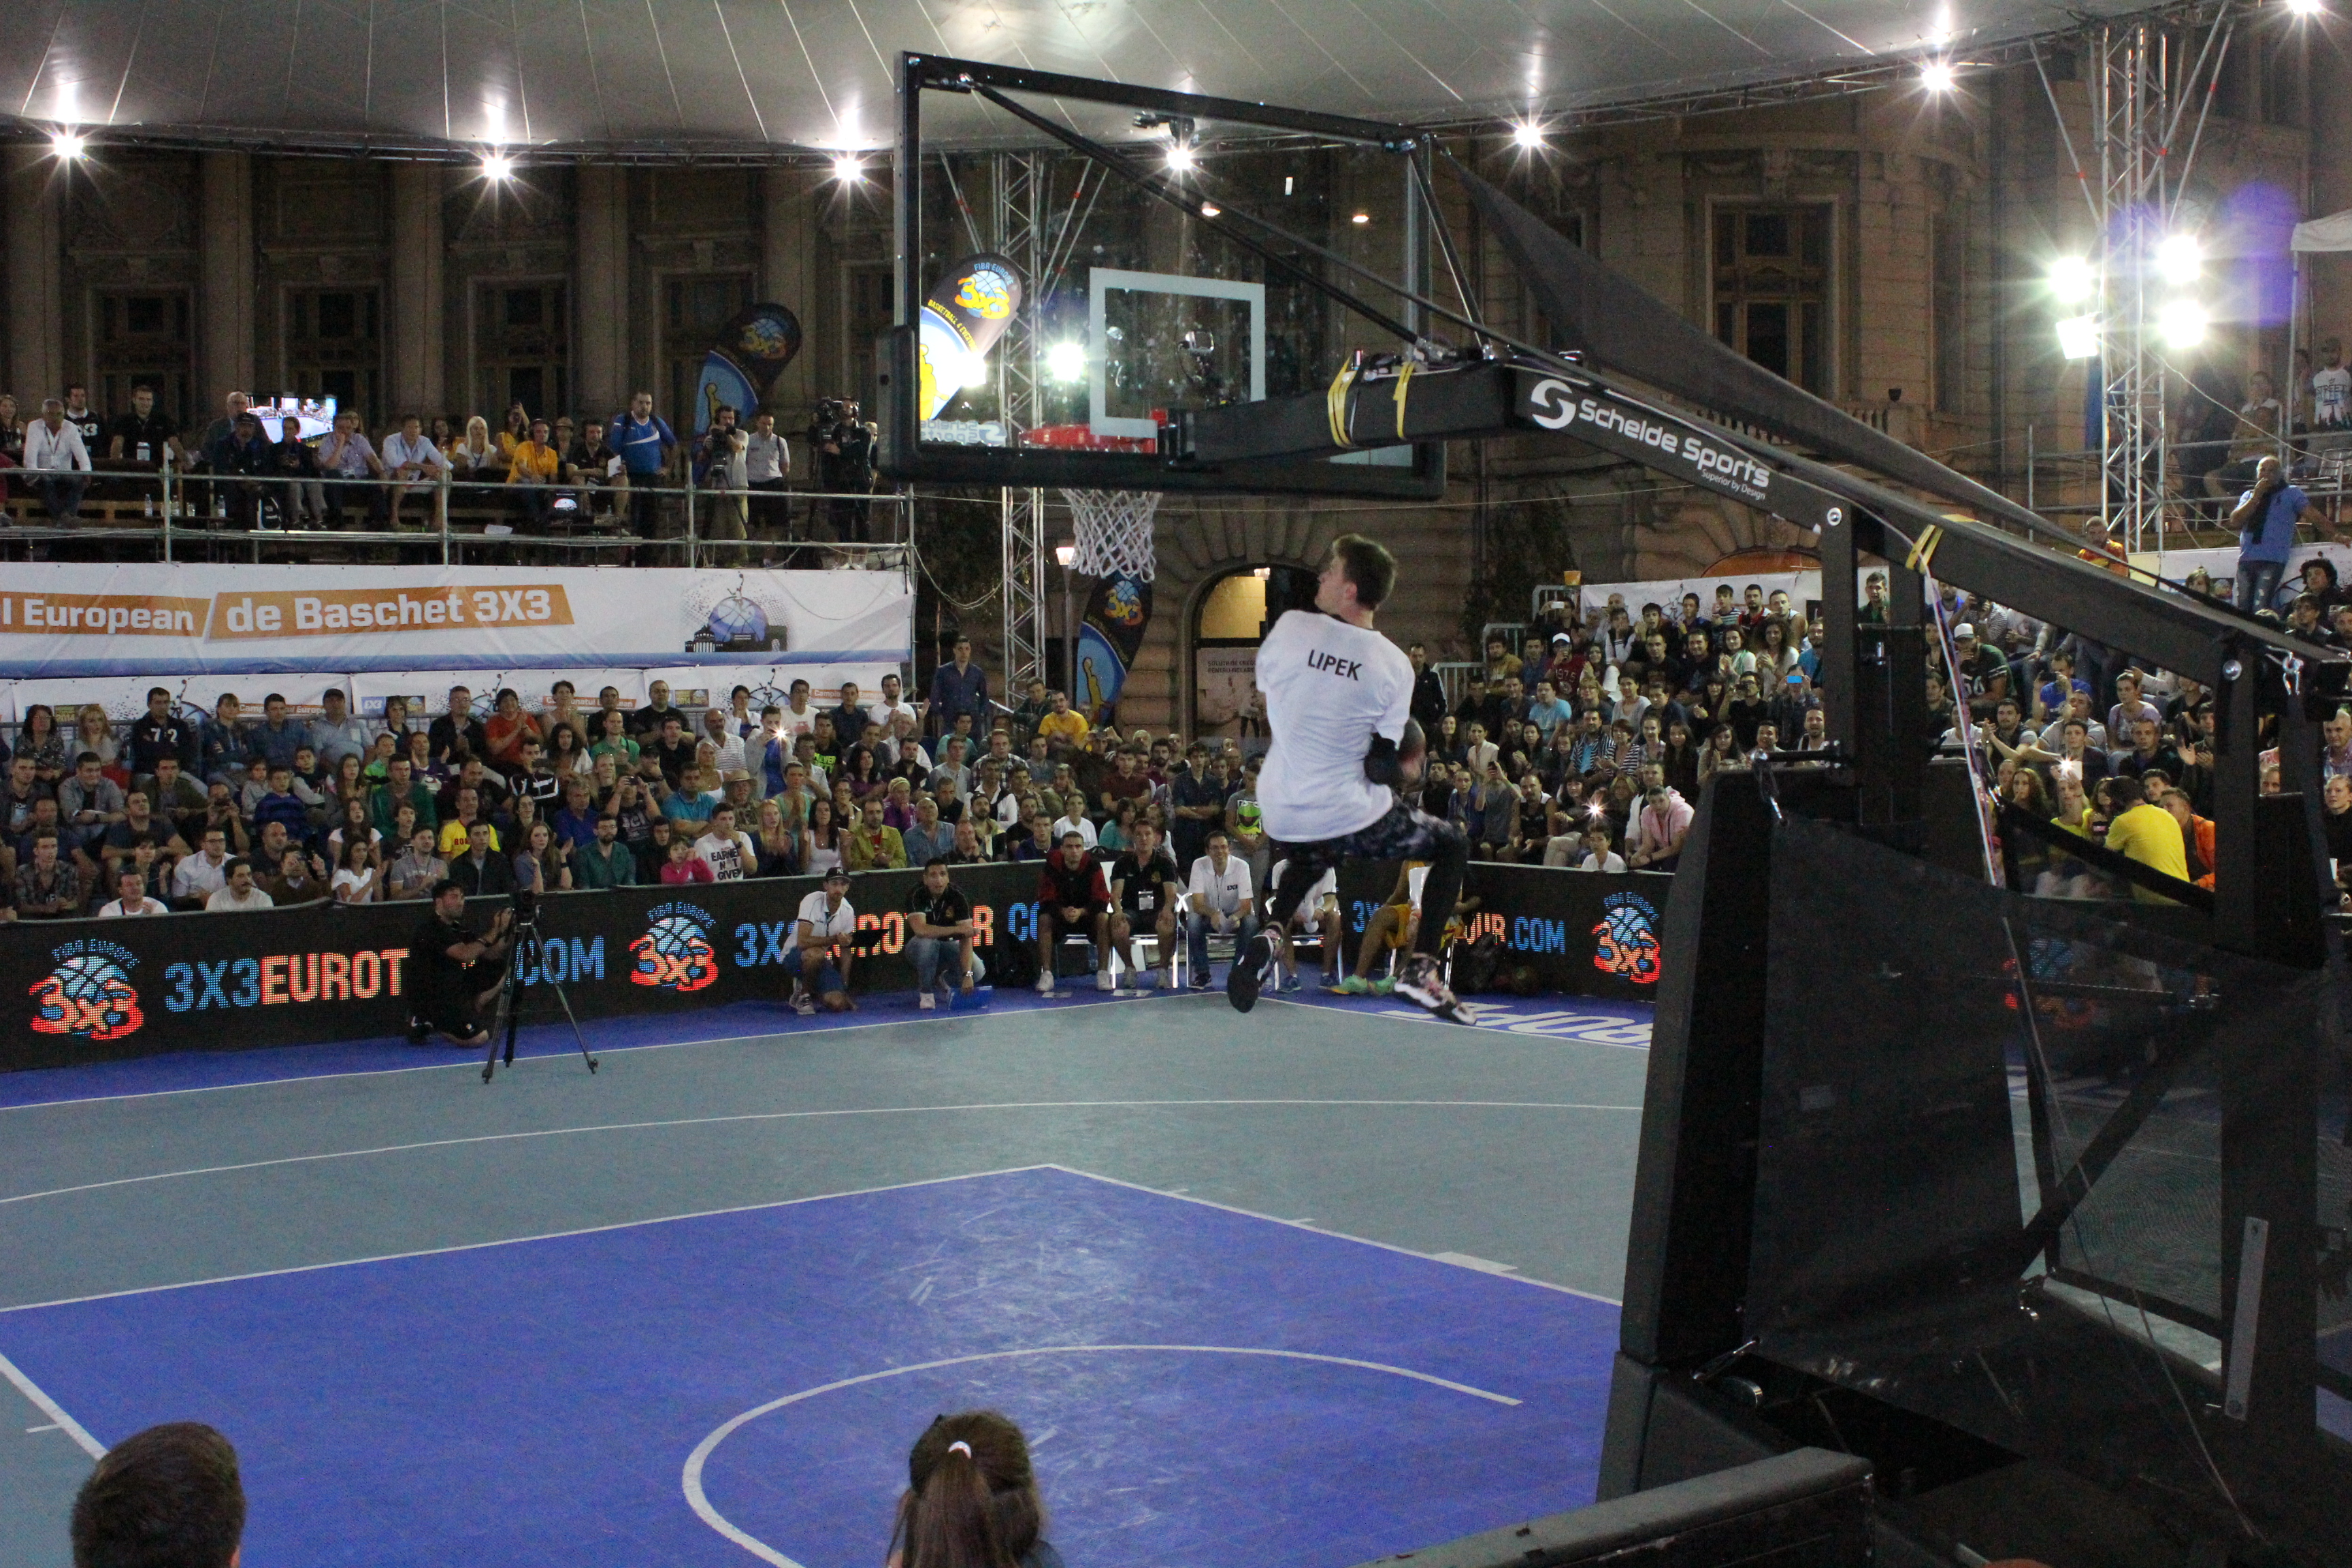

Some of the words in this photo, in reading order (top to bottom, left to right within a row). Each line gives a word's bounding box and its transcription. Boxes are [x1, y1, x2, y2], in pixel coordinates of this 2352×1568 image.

[974, 262, 990, 271] FIBA
[992, 263, 1014, 286] EUROPE
[928, 299, 958, 325] BASKETBALL
[1578, 398, 1678, 453] Schelde
[1682, 437, 1769, 487] Sports
[1701, 469, 1731, 486] Superior
[1731, 480, 1741, 492] by
[1742, 484, 1765, 500] Design
[24, 599, 193, 634] European
[227, 598, 281, 632] de
[295, 594, 464, 630] Baschet
[474, 589, 551, 622] 3X3
[1308, 649, 1362, 681] LIPEK
[711, 848, 739, 862] EARNE
